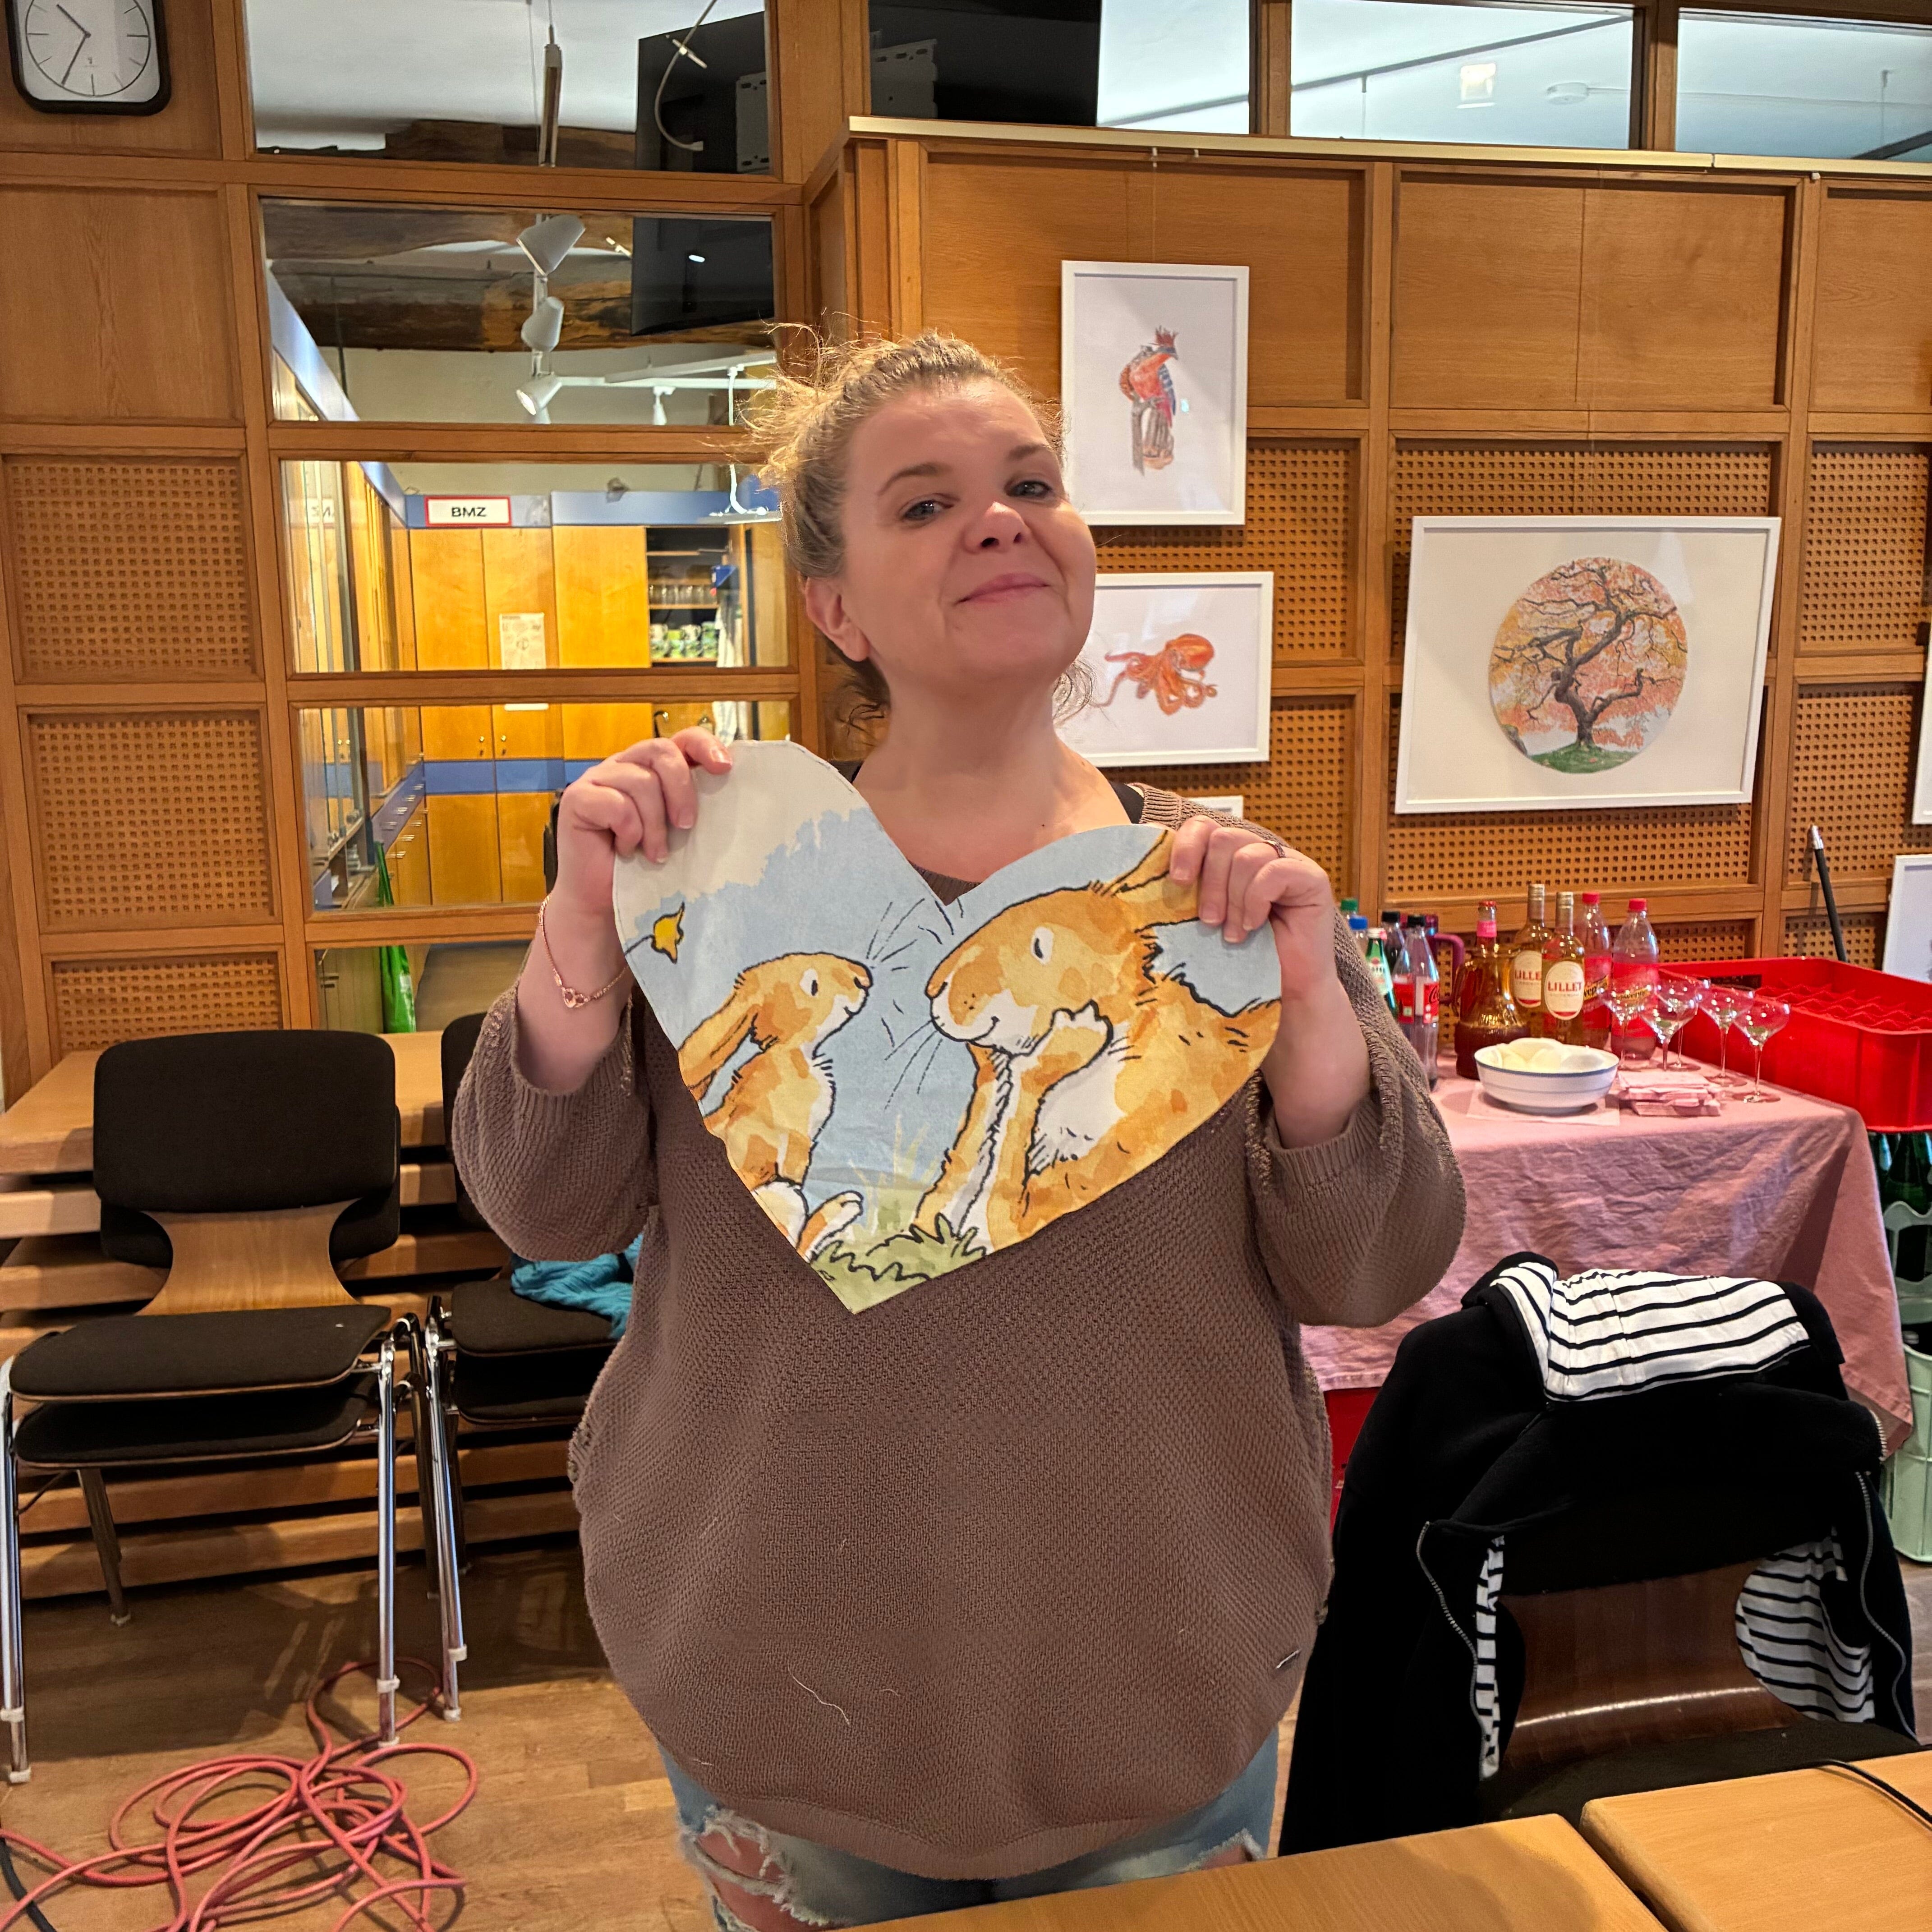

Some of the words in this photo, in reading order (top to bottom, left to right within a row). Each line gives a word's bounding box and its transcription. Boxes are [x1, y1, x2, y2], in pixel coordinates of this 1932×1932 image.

[451, 507, 487, 518] BMZ
[1515, 970, 1541, 980] LILLE
[1547, 980, 1582, 992] LILLET
